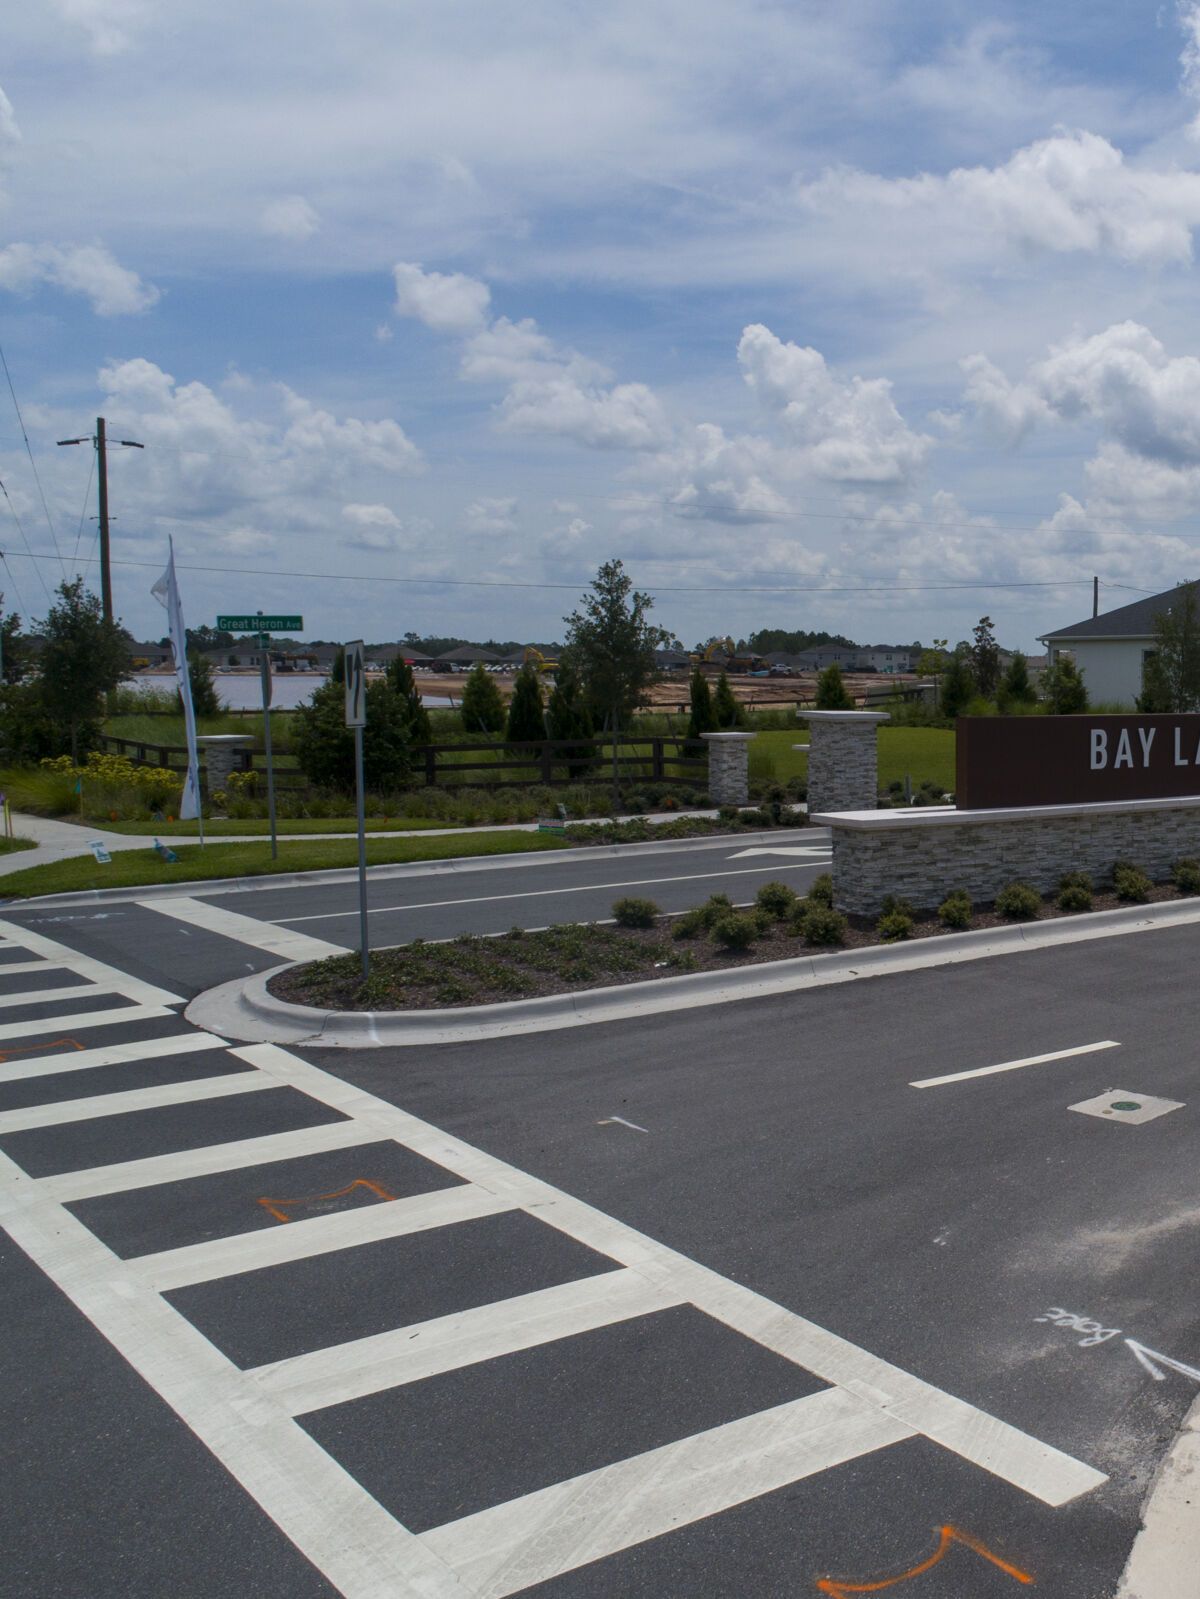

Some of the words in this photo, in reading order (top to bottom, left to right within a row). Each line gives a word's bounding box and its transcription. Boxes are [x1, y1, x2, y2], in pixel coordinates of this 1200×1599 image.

[220, 619, 249, 629] Great
[251, 618, 283, 629] Heron
[1090, 728, 1156, 770] BAY
